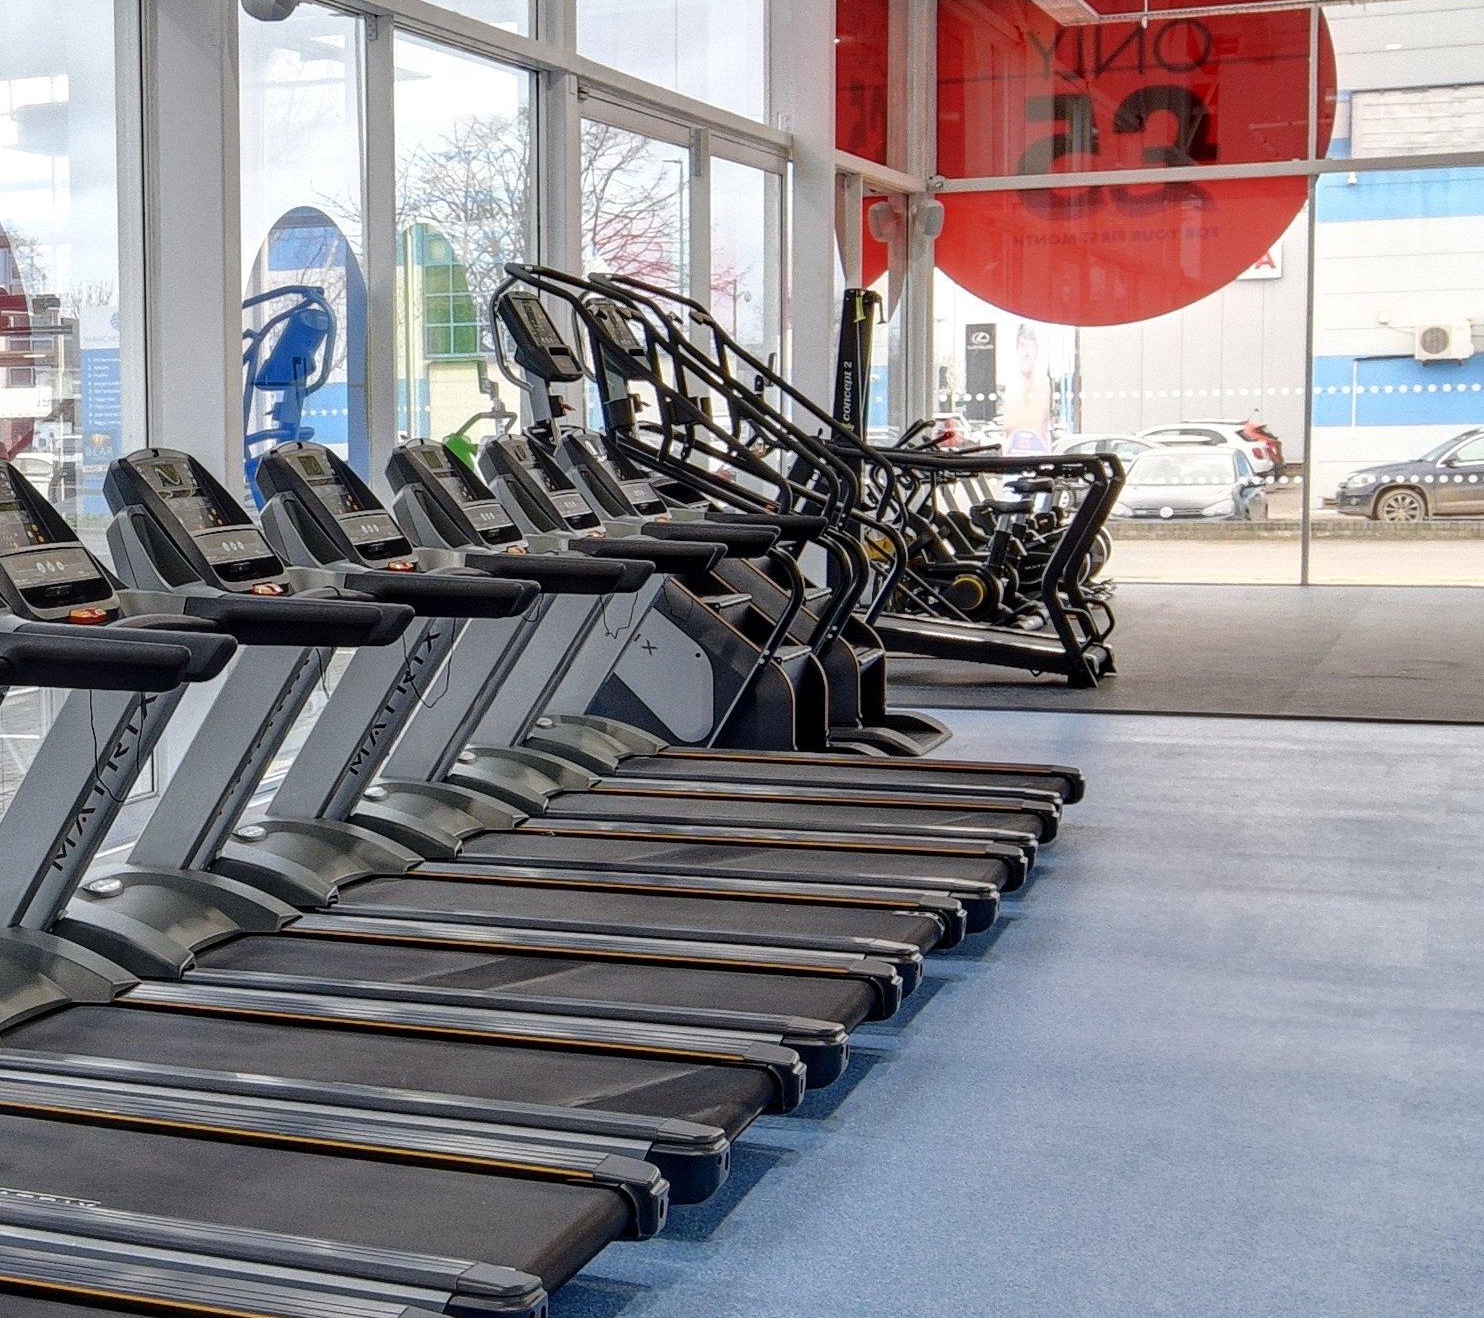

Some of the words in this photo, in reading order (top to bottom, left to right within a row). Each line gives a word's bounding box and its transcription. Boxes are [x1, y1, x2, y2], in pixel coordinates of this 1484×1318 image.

[842, 371, 853, 423] concept
[843, 360, 853, 369] 2
[348, 631, 441, 777] MATRIX
[52, 693, 158, 872] MATRIX
